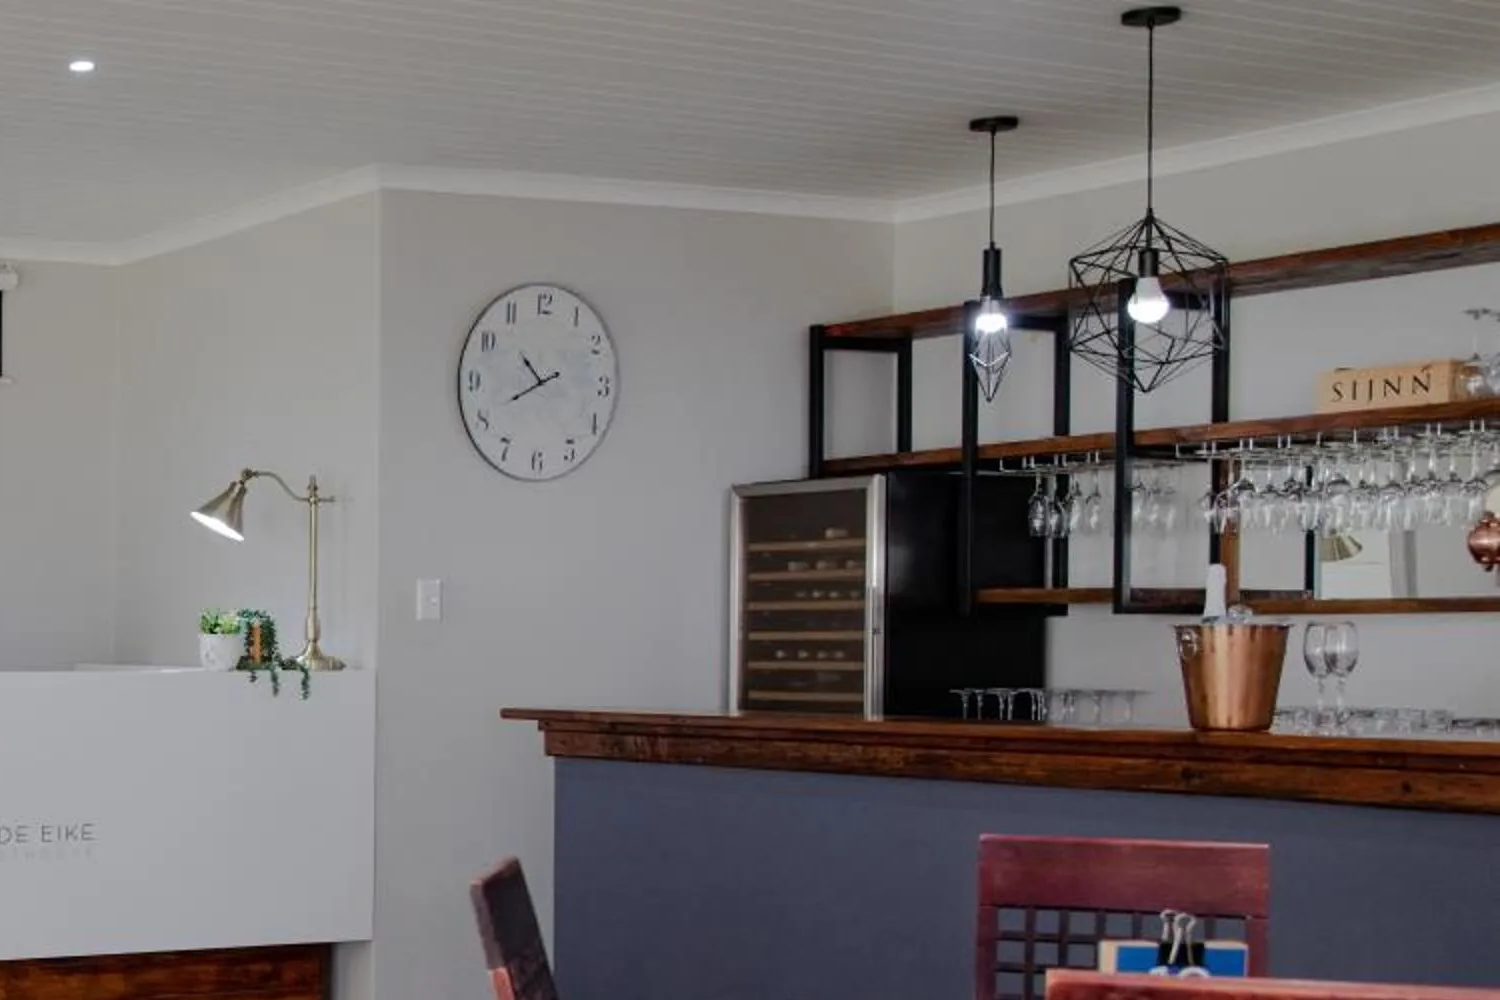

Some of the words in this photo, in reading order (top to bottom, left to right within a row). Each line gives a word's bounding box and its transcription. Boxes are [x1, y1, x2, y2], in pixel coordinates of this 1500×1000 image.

[506, 301, 517, 325] 11
[537, 293, 553, 315] 12
[574, 305, 580, 327] 1
[481, 332, 497, 352] 10
[590, 334, 602, 356] 2
[468, 370, 481, 393] 9
[597, 376, 610, 397] 3
[500, 437, 511, 461] 7
[563, 439, 576, 462] 5
[531, 451, 544, 472] 6
[41, 823, 97, 843] EIKE
